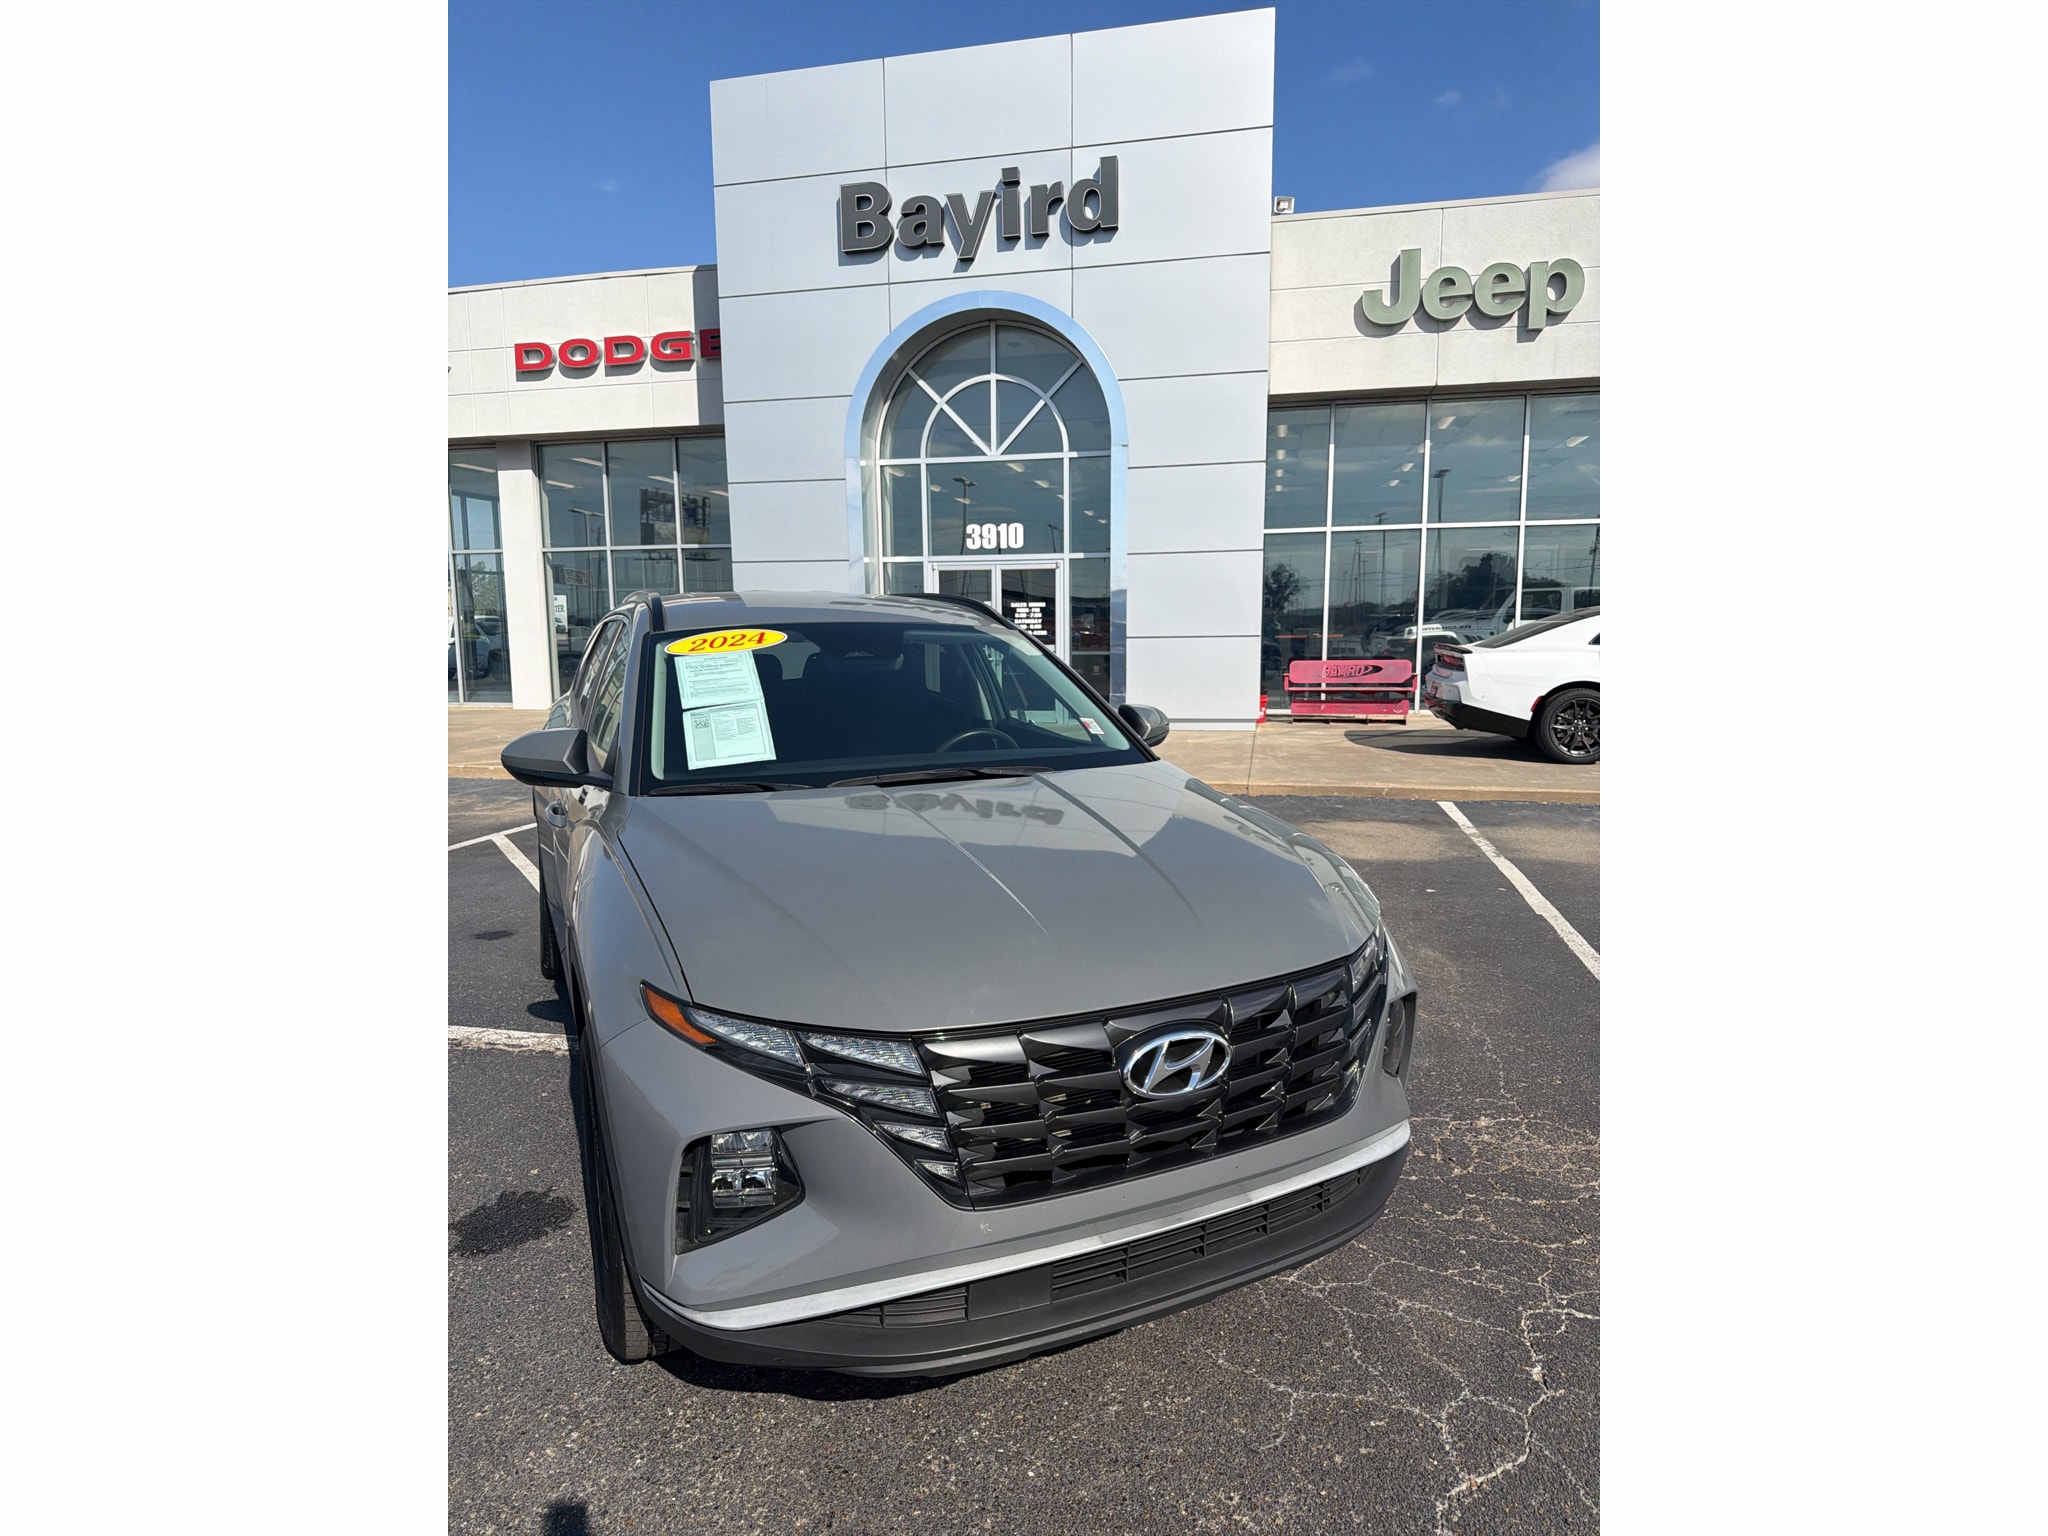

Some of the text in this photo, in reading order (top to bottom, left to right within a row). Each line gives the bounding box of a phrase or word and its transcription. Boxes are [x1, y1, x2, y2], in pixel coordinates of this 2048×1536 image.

[839, 155, 1119, 262] Bayird
[1362, 248, 1586, 331] Jeep
[965, 522, 1024, 550] 3910
[687, 631, 767, 653] 2024
[1321, 664, 1364, 678] BAYIRD
